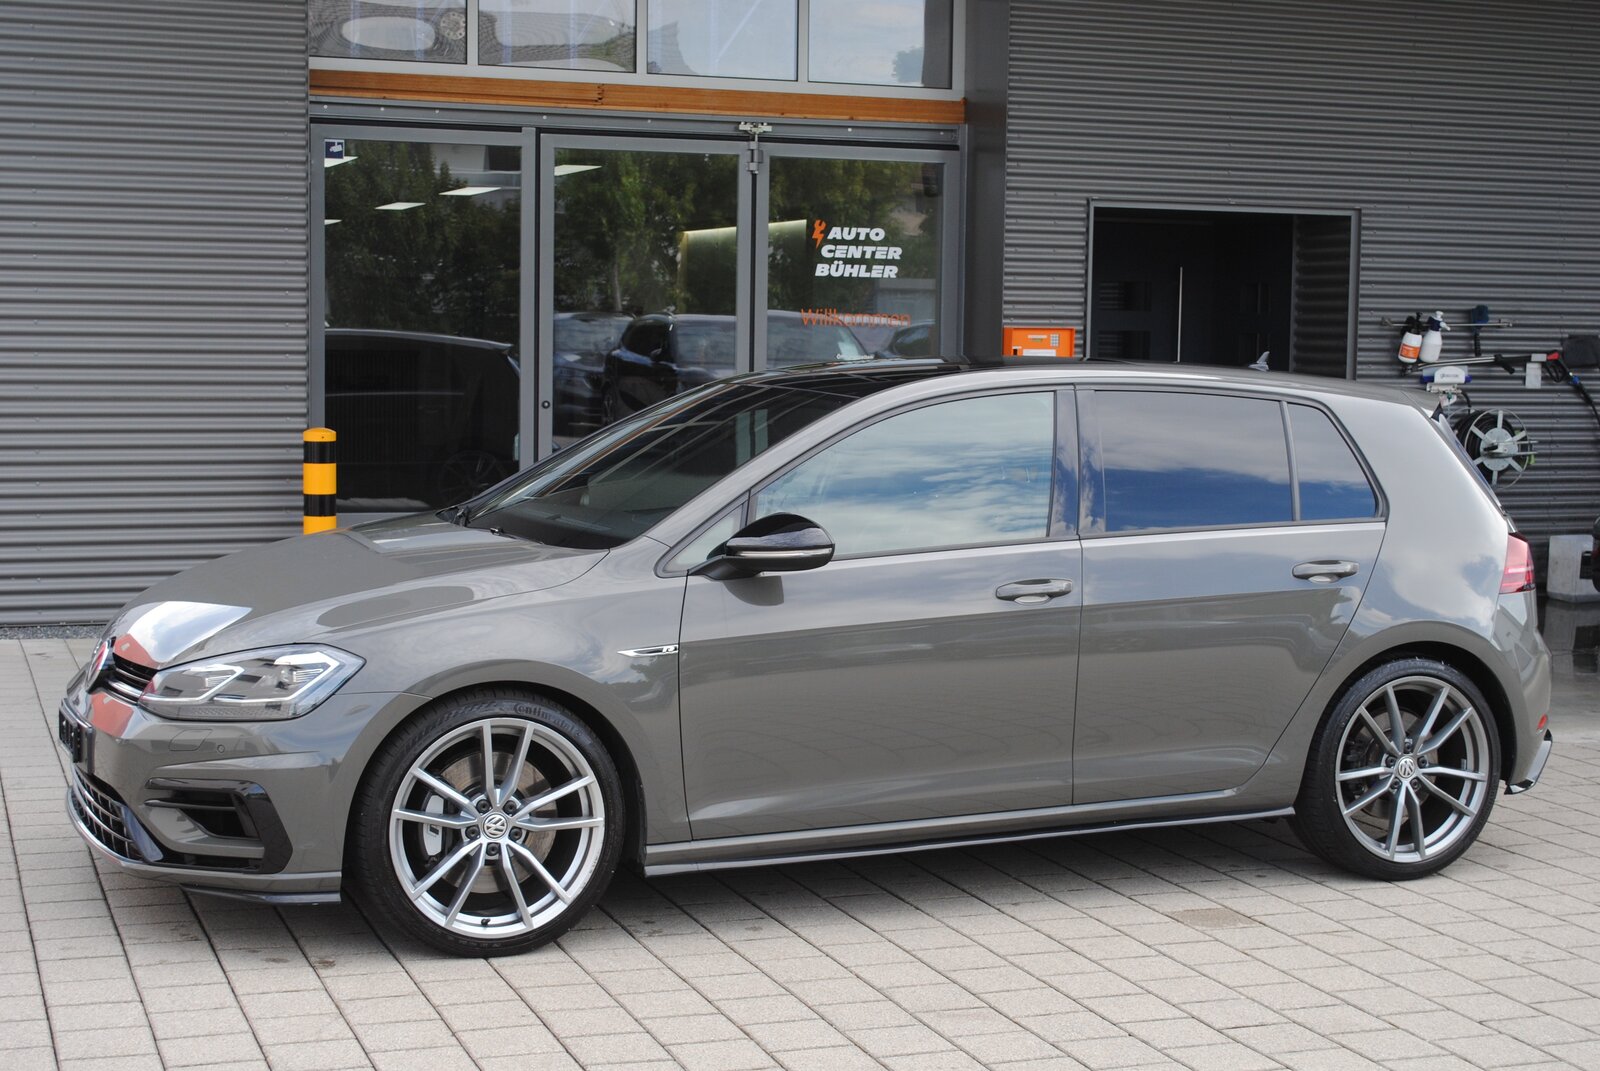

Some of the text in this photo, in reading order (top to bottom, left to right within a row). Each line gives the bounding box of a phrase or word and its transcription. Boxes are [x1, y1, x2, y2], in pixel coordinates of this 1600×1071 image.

[827, 226, 885, 242] AUTO
[821, 245, 903, 260] CENTER
[815, 260, 899, 279] BÜHLER
[800, 308, 911, 328] Willkommen
